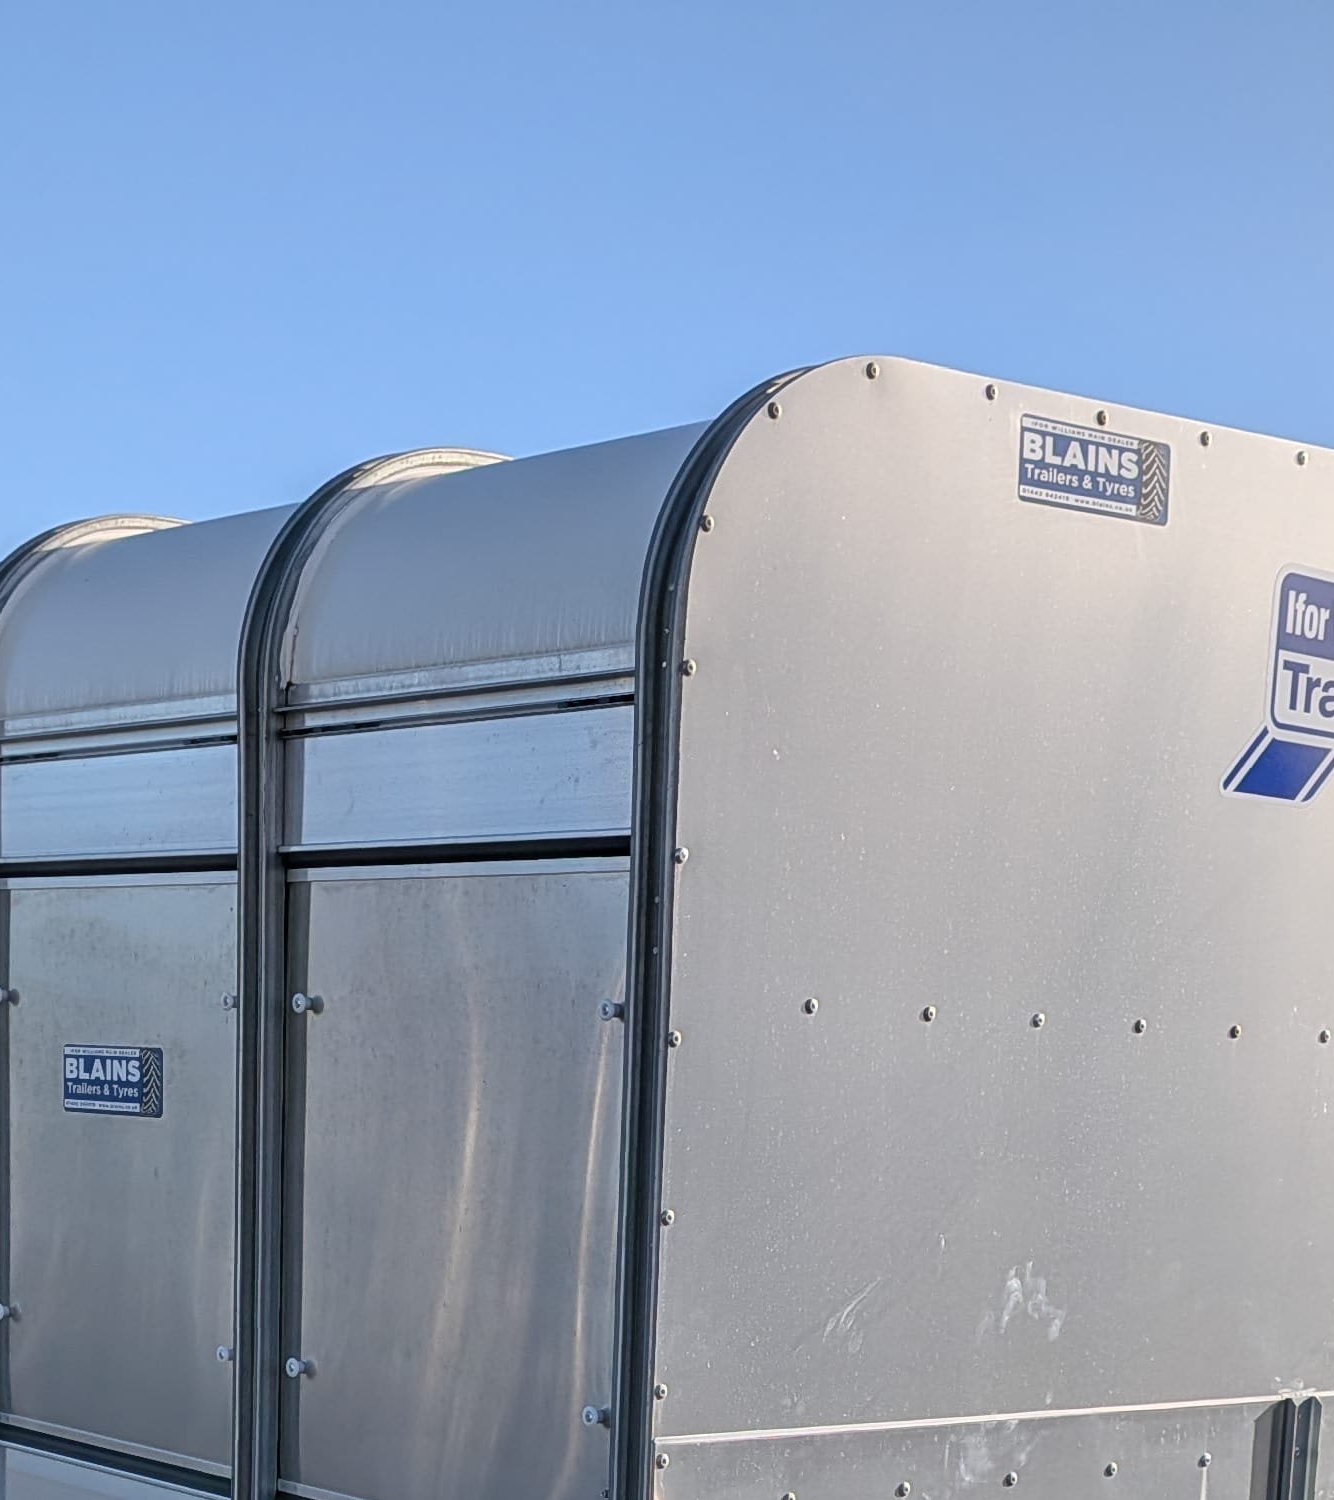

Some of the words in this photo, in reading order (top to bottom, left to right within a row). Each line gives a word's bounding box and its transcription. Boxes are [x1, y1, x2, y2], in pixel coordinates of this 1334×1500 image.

[1051, 425, 1085, 437] WILLIAMS
[1107, 436, 1134, 447] DEALER
[1022, 431, 1140, 480] BLAINS
[1024, 463, 1079, 487] Trailers
[1082, 475, 1093, 490] &
[1096, 477, 1135, 498] Tyres
[1285, 589, 1330, 641] Ifor
[65, 1057, 141, 1082] BLAINS
[67, 1082, 101, 1096] Trailers
[103, 1084, 110, 1096] &
[112, 1084, 139, 1098] Tyres
